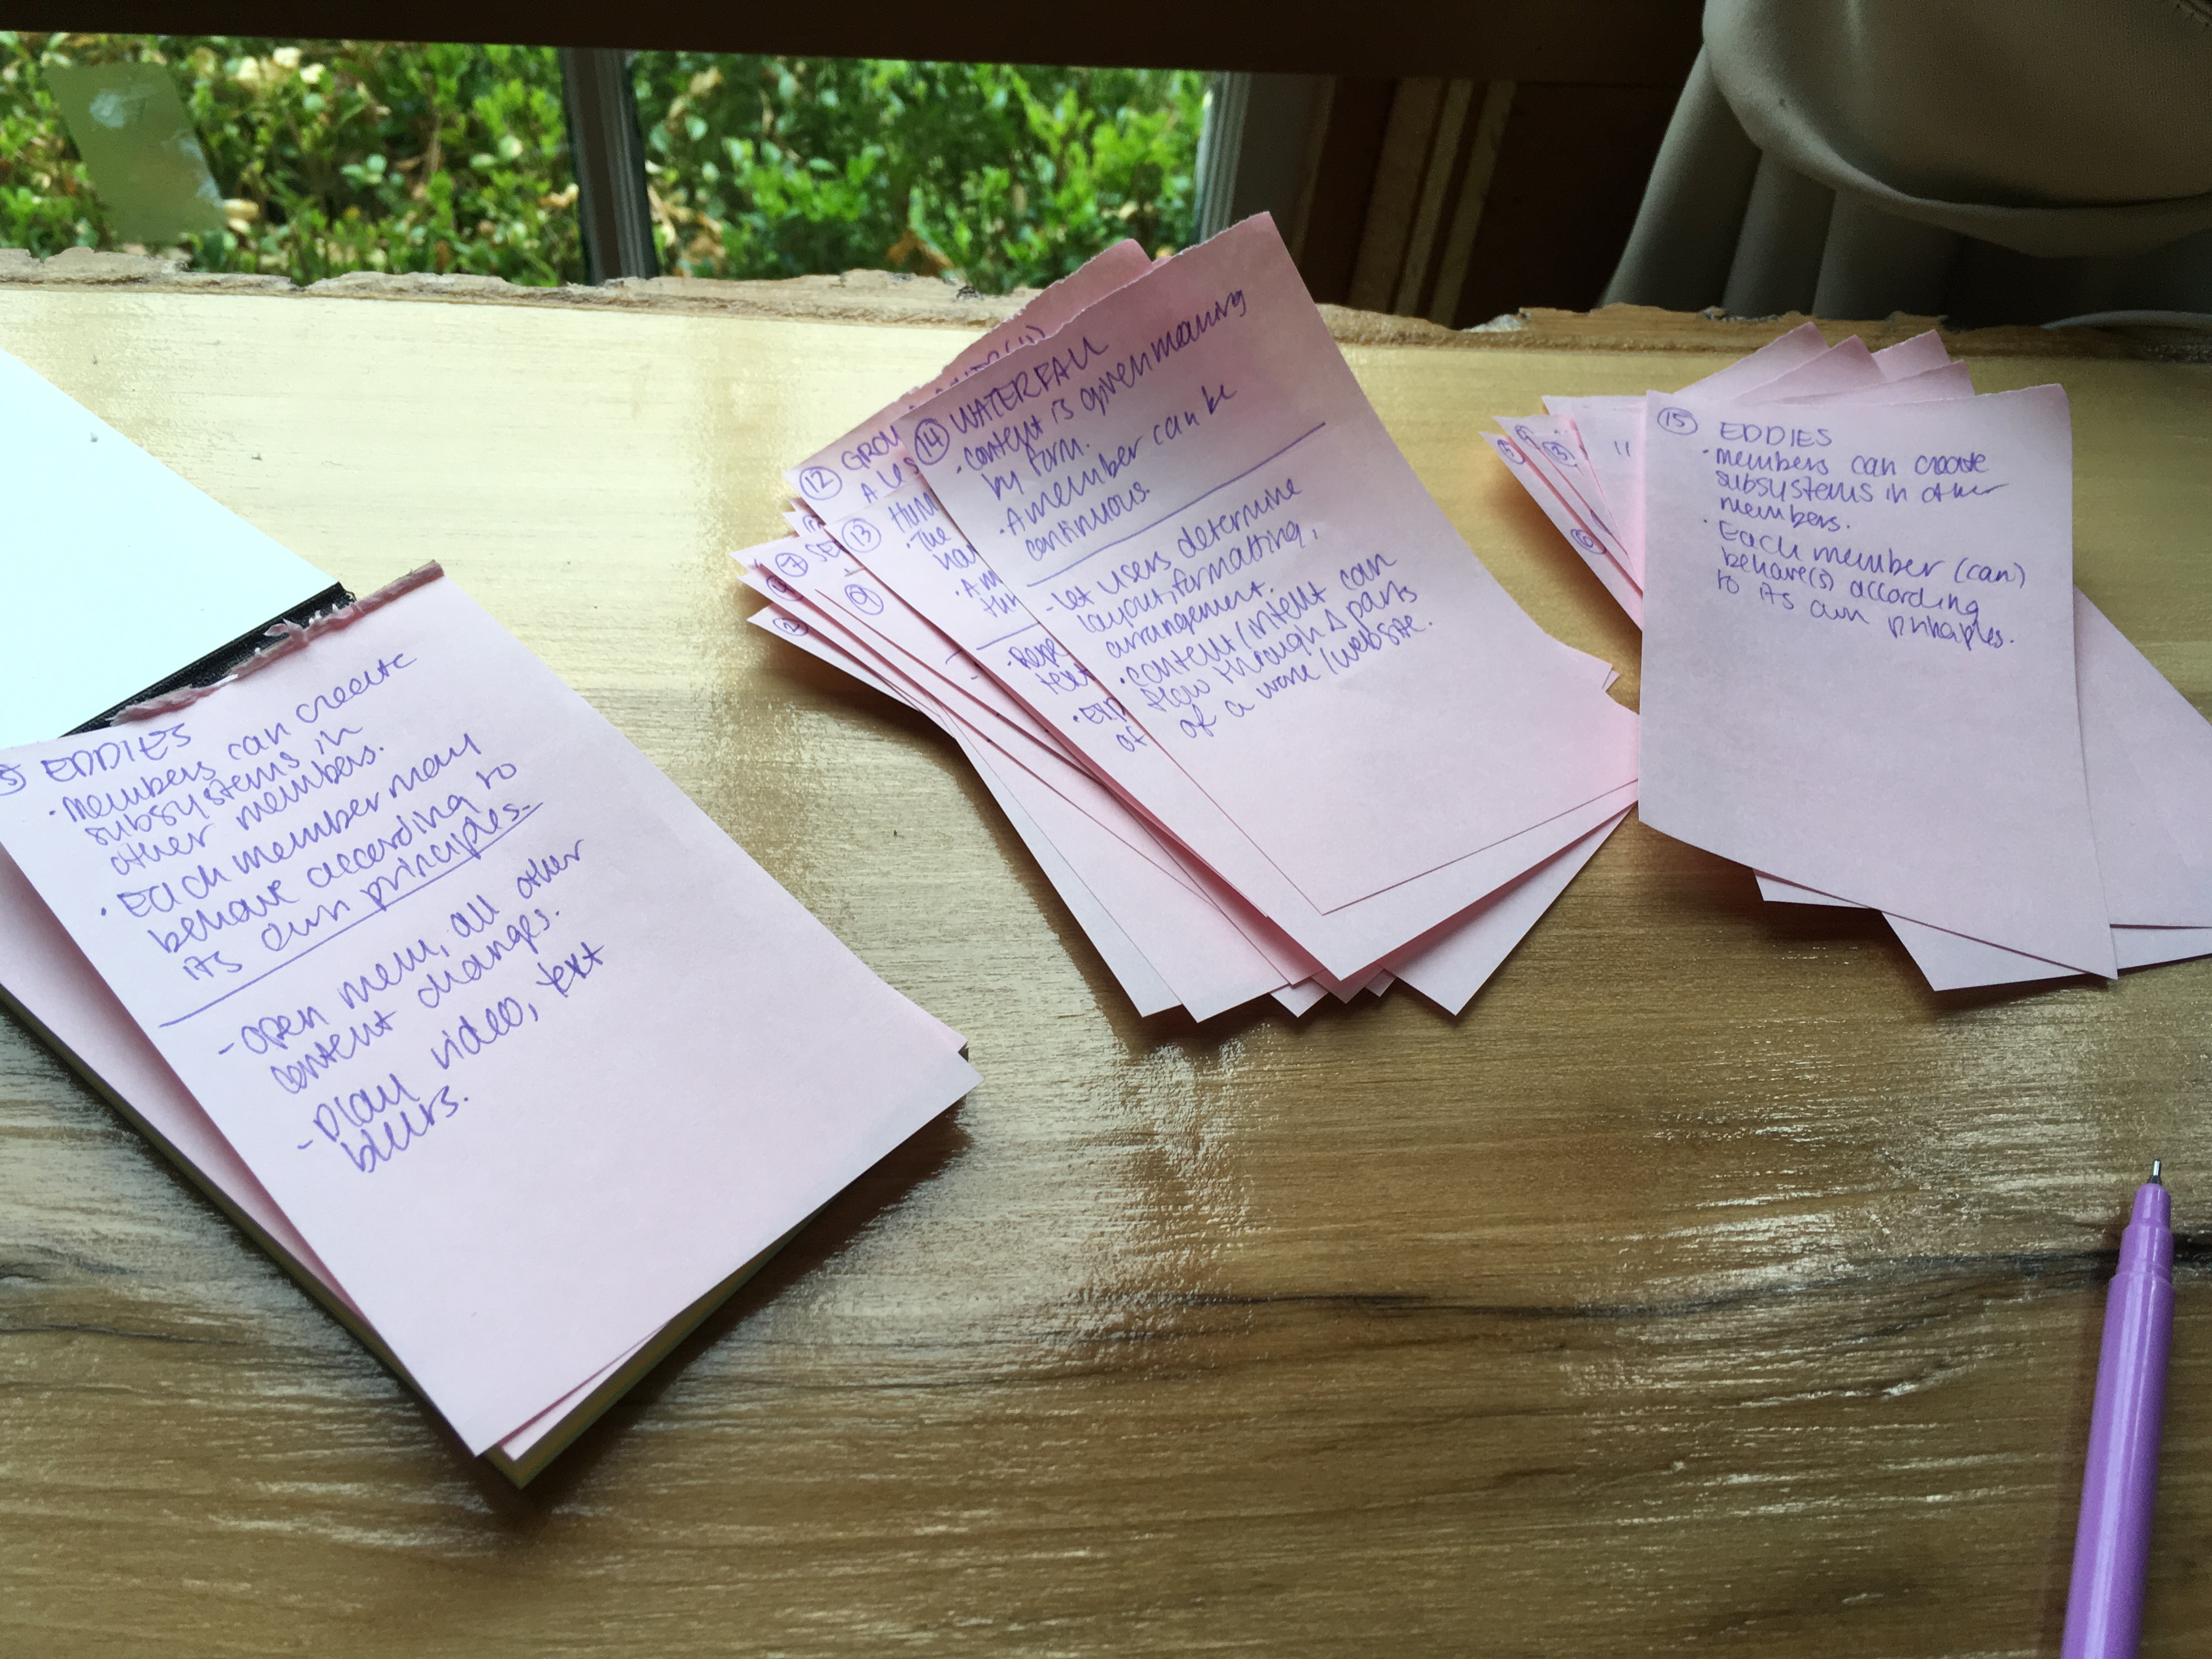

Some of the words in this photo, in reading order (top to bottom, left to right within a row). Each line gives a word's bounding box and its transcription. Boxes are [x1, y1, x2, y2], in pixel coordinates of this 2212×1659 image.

[1052, 399, 1074, 423] is
[1153, 411, 1200, 447] can
[1720, 421, 1833, 448] EDDIES
[1716, 470, 1874, 503] subsystems
[1886, 483, 1908, 503] in
[1851, 454, 1897, 477] can
[1097, 551, 1171, 595] users
[1178, 478, 1302, 558] determine
[1720, 520, 1803, 561] Each
[1814, 546, 1945, 578] member
[1954, 556, 2025, 588] (can)
[1340, 553, 1397, 591] can
[1717, 569, 1740, 594] to
[1346, 580, 1417, 631] parts
[1850, 580, 1979, 617] according
[1180, 704, 1217, 738] of
[1224, 699, 1255, 718] a
[41, 723, 191, 782] EDDIES
[228, 723, 291, 760] can
[85, 752, 300, 845] subsystems
[315, 727, 363, 755] in
[111, 823, 215, 875] other
[236, 745, 384, 830] members.
[307, 794, 479, 887] according
[476, 763, 517, 789] to
[233, 792, 379, 874] member
[450, 895, 500, 937] all
[517, 839, 584, 899] other
[536, 941, 605, 997] text
